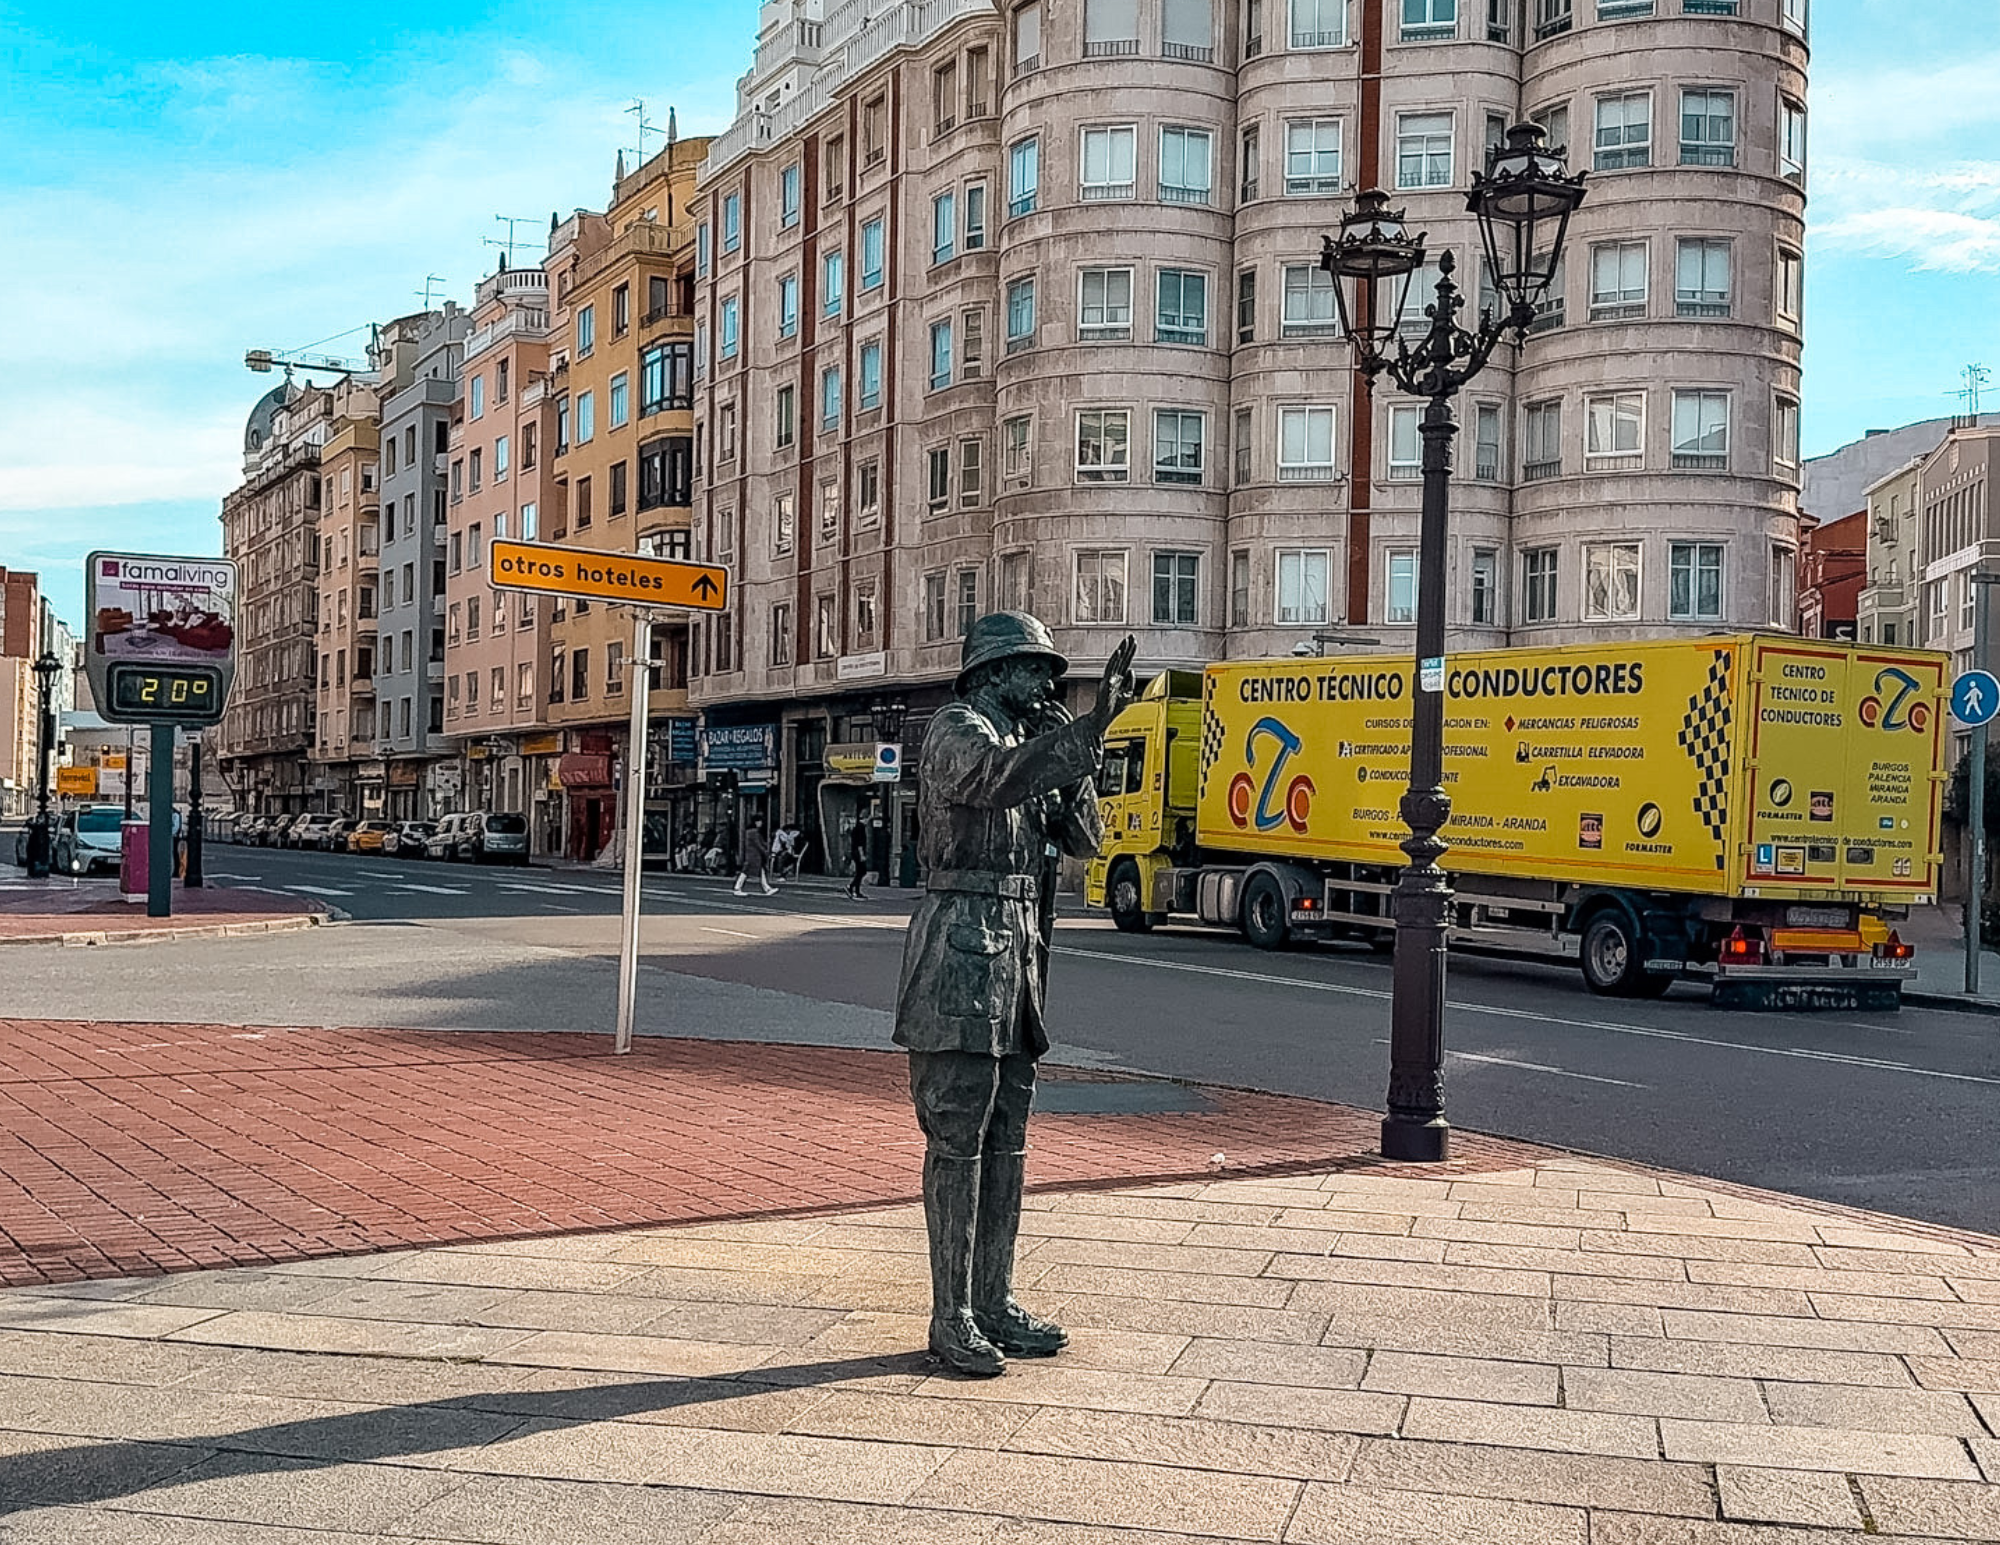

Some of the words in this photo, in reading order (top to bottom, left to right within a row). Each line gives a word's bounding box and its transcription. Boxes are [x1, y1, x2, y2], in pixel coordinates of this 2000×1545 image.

[121, 561, 228, 589] famaliving
[500, 556, 566, 579] otros
[576, 563, 664, 590] hoteles
[1782, 663, 1826, 680] CENTRO
[1239, 675, 1312, 703] CENTRO
[1316, 666, 1404, 701] TÉCNICO
[1447, 662, 1644, 699] CONDUCTORES
[1770, 683, 1818, 702] TÉCNICO
[1820, 690, 1835, 704] DE
[1365, 718, 1401, 729] CURSOS
[1474, 718, 1491, 729] EN:
[1518, 717, 1576, 730] MERCANCIAS
[1580, 716, 1640, 729] PELIGROSAS
[1761, 708, 1842, 728] CONDUCTORES
[708, 730, 729, 745] BAZAR
[732, 727, 763, 744] REGALOS
[1354, 744, 1399, 755] CERTIFICADO
[1531, 746, 1583, 758] CARRETILLA
[1588, 746, 1644, 760] ELEVADORA
[1871, 762, 1910, 772] BURGOS
[1558, 775, 1620, 788] EXCAVADORA
[1867, 772, 1912, 784] PALENCIA
[1869, 783, 1910, 794] MIRANDA
[1870, 794, 1908, 804] ARANDA
[1353, 808, 1390, 821] BURGOS
[1449, 813, 1494, 828] MIRANDA
[1502, 817, 1547, 832] ARANDA
[1757, 811, 1803, 821] FORMASTER
[1624, 842, 1673, 855] FORMASTER
[1760, 847, 1769, 863] L
